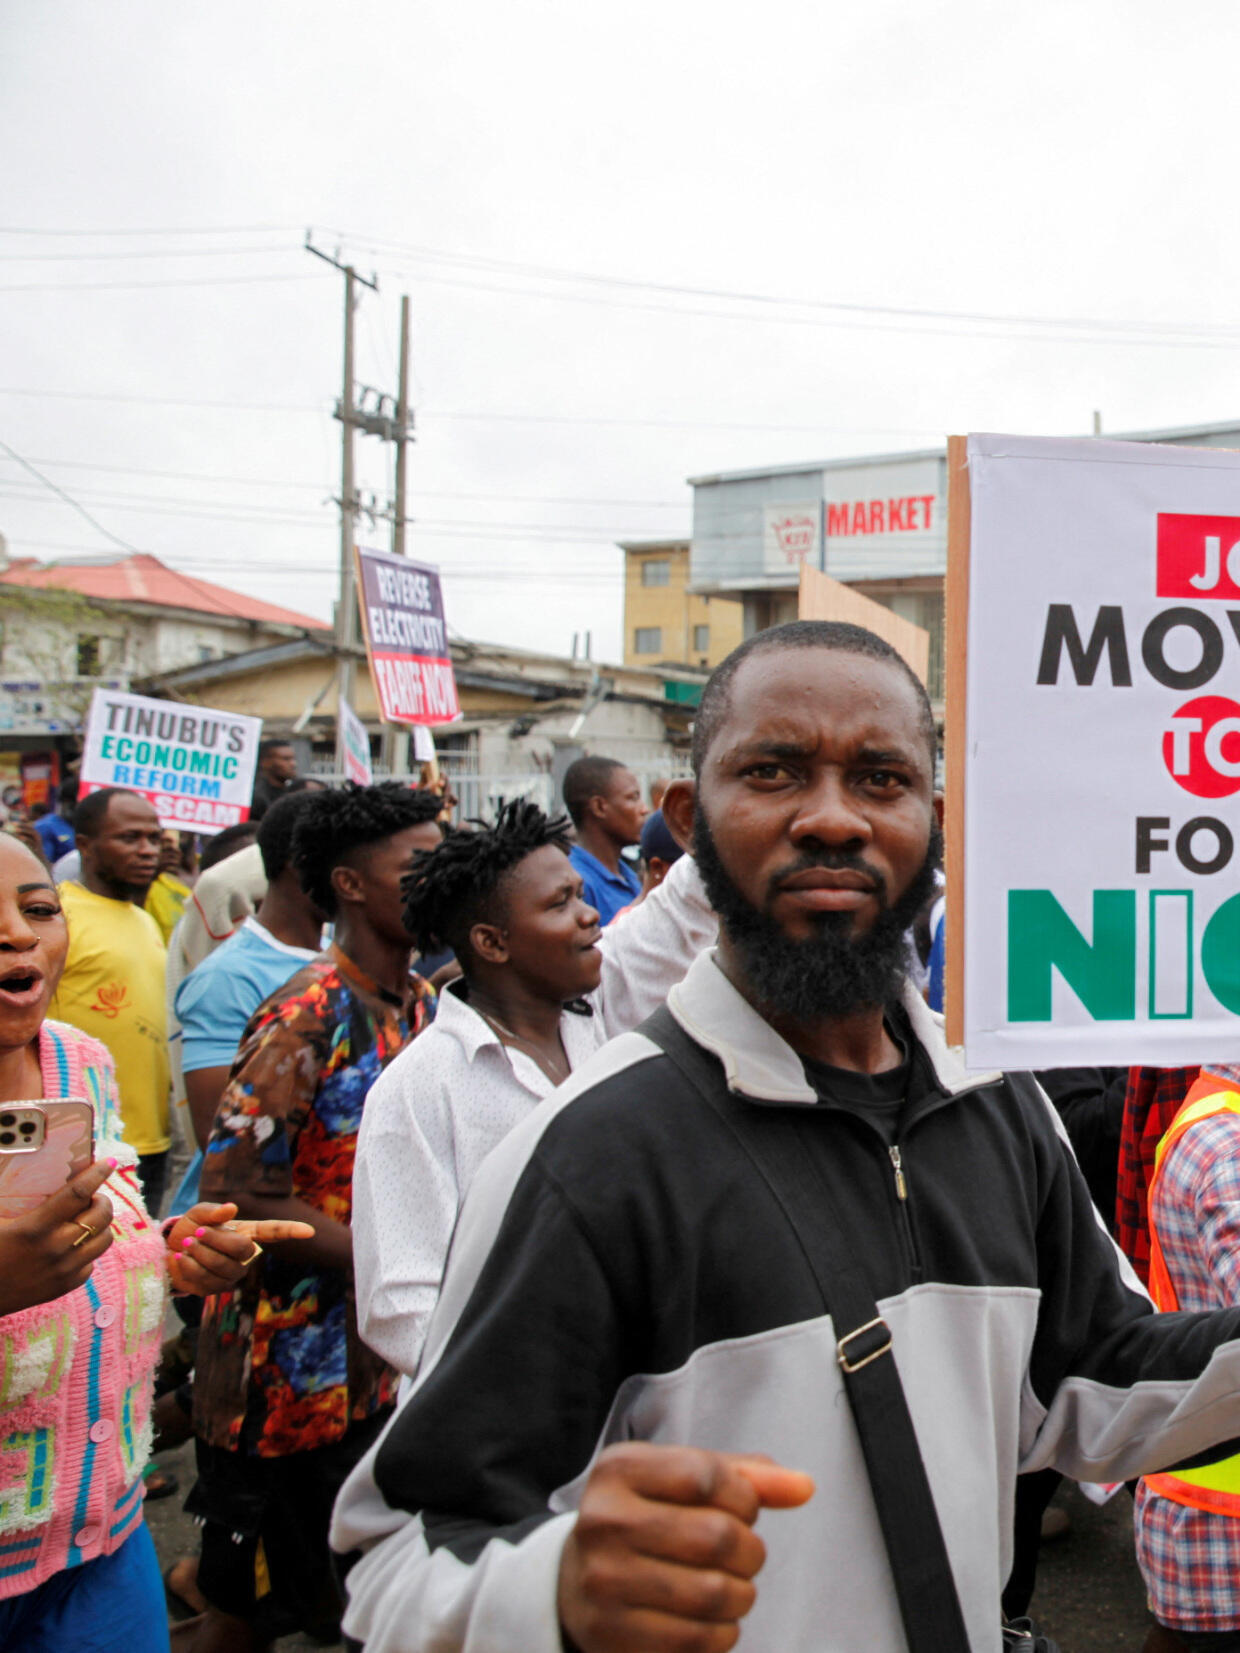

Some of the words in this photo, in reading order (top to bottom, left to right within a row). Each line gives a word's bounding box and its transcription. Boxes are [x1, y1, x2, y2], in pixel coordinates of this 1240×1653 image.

[827, 495, 935, 537] MARKET
[376, 565, 432, 611] REVERSE
[369, 606, 446, 651] ELECTRICITY
[421, 662, 459, 716] NOW
[105, 702, 246, 753] TINUBU'S
[101, 735, 239, 780] ECONOMIC
[113, 764, 222, 799] REFORM
[154, 795, 242, 827] SCAM
